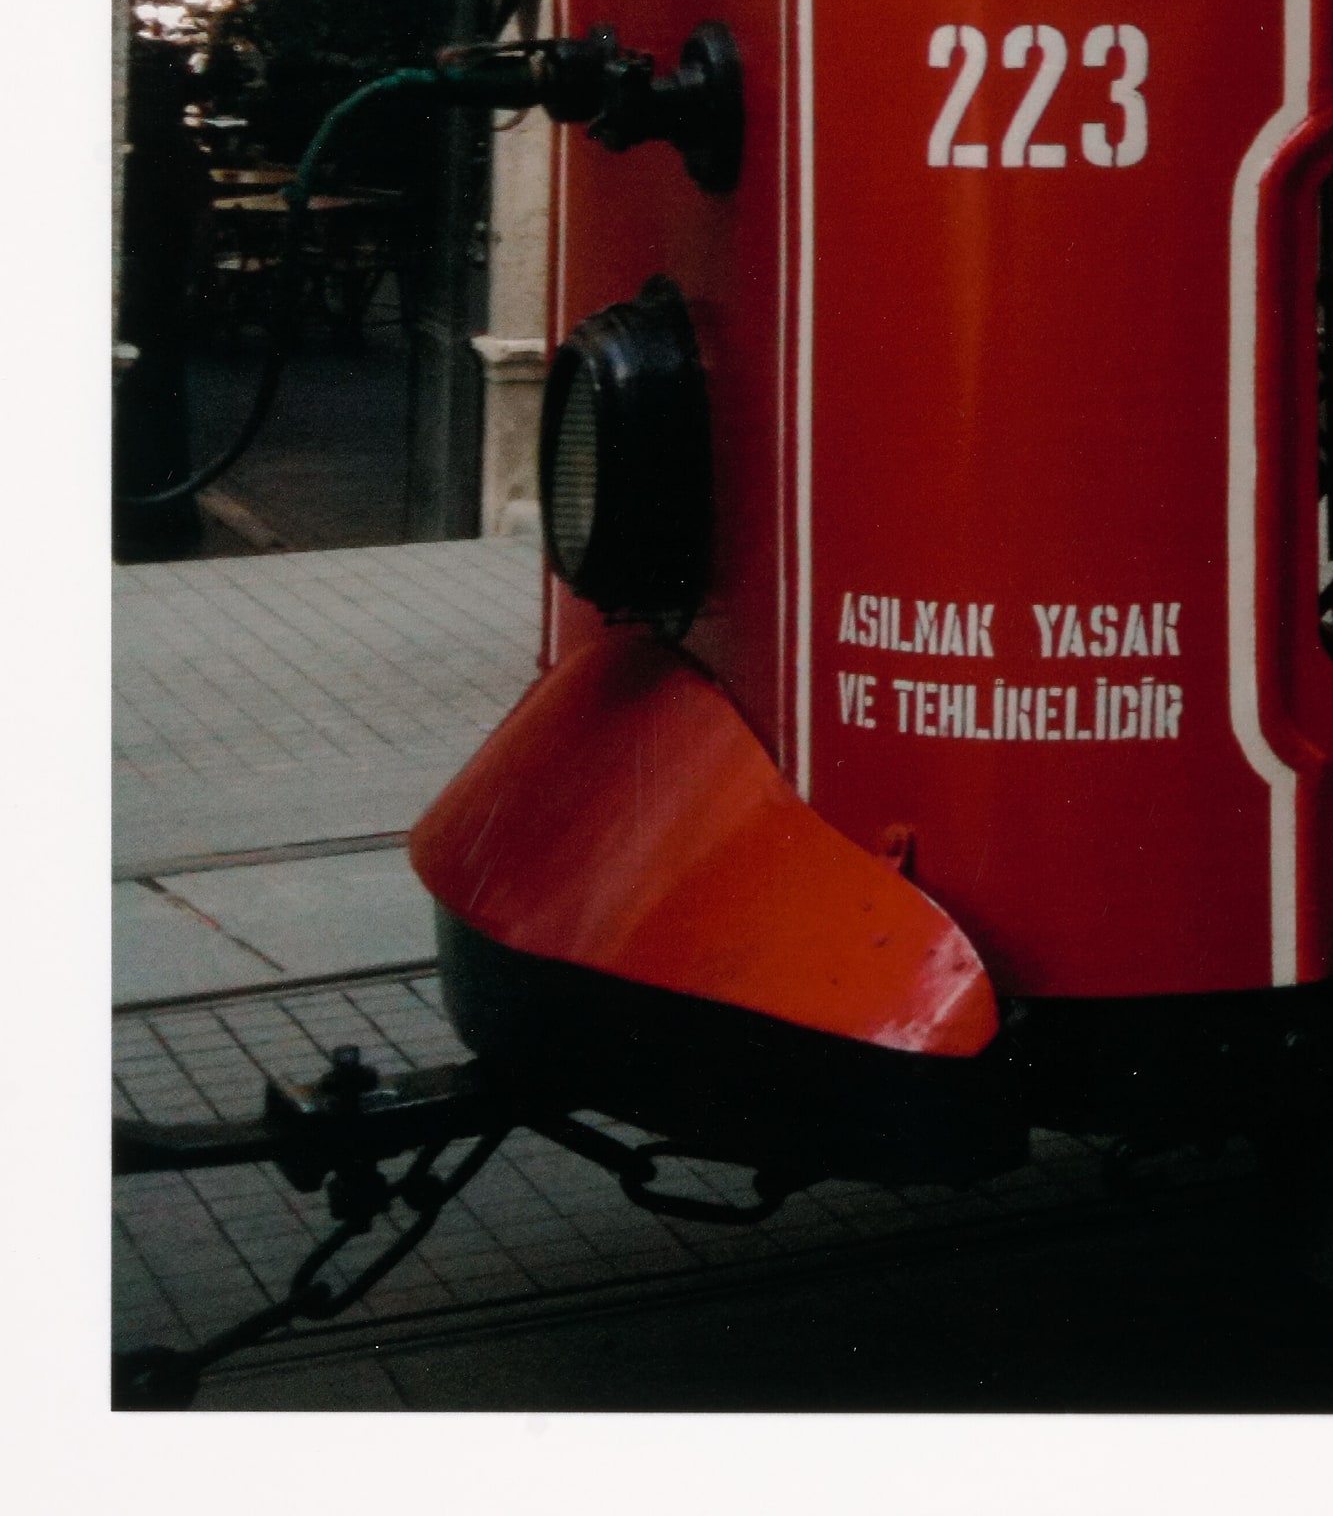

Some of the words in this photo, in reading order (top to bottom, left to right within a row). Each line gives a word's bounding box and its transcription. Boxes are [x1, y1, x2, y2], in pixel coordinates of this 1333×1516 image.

[927, 24, 1149, 169] 223
[838, 592, 995, 658] ASILMAK
[1032, 602, 1182, 658] YASAK
[838, 671, 877, 729] VE
[892, 676, 1184, 741] TEHLİKELİDİR
